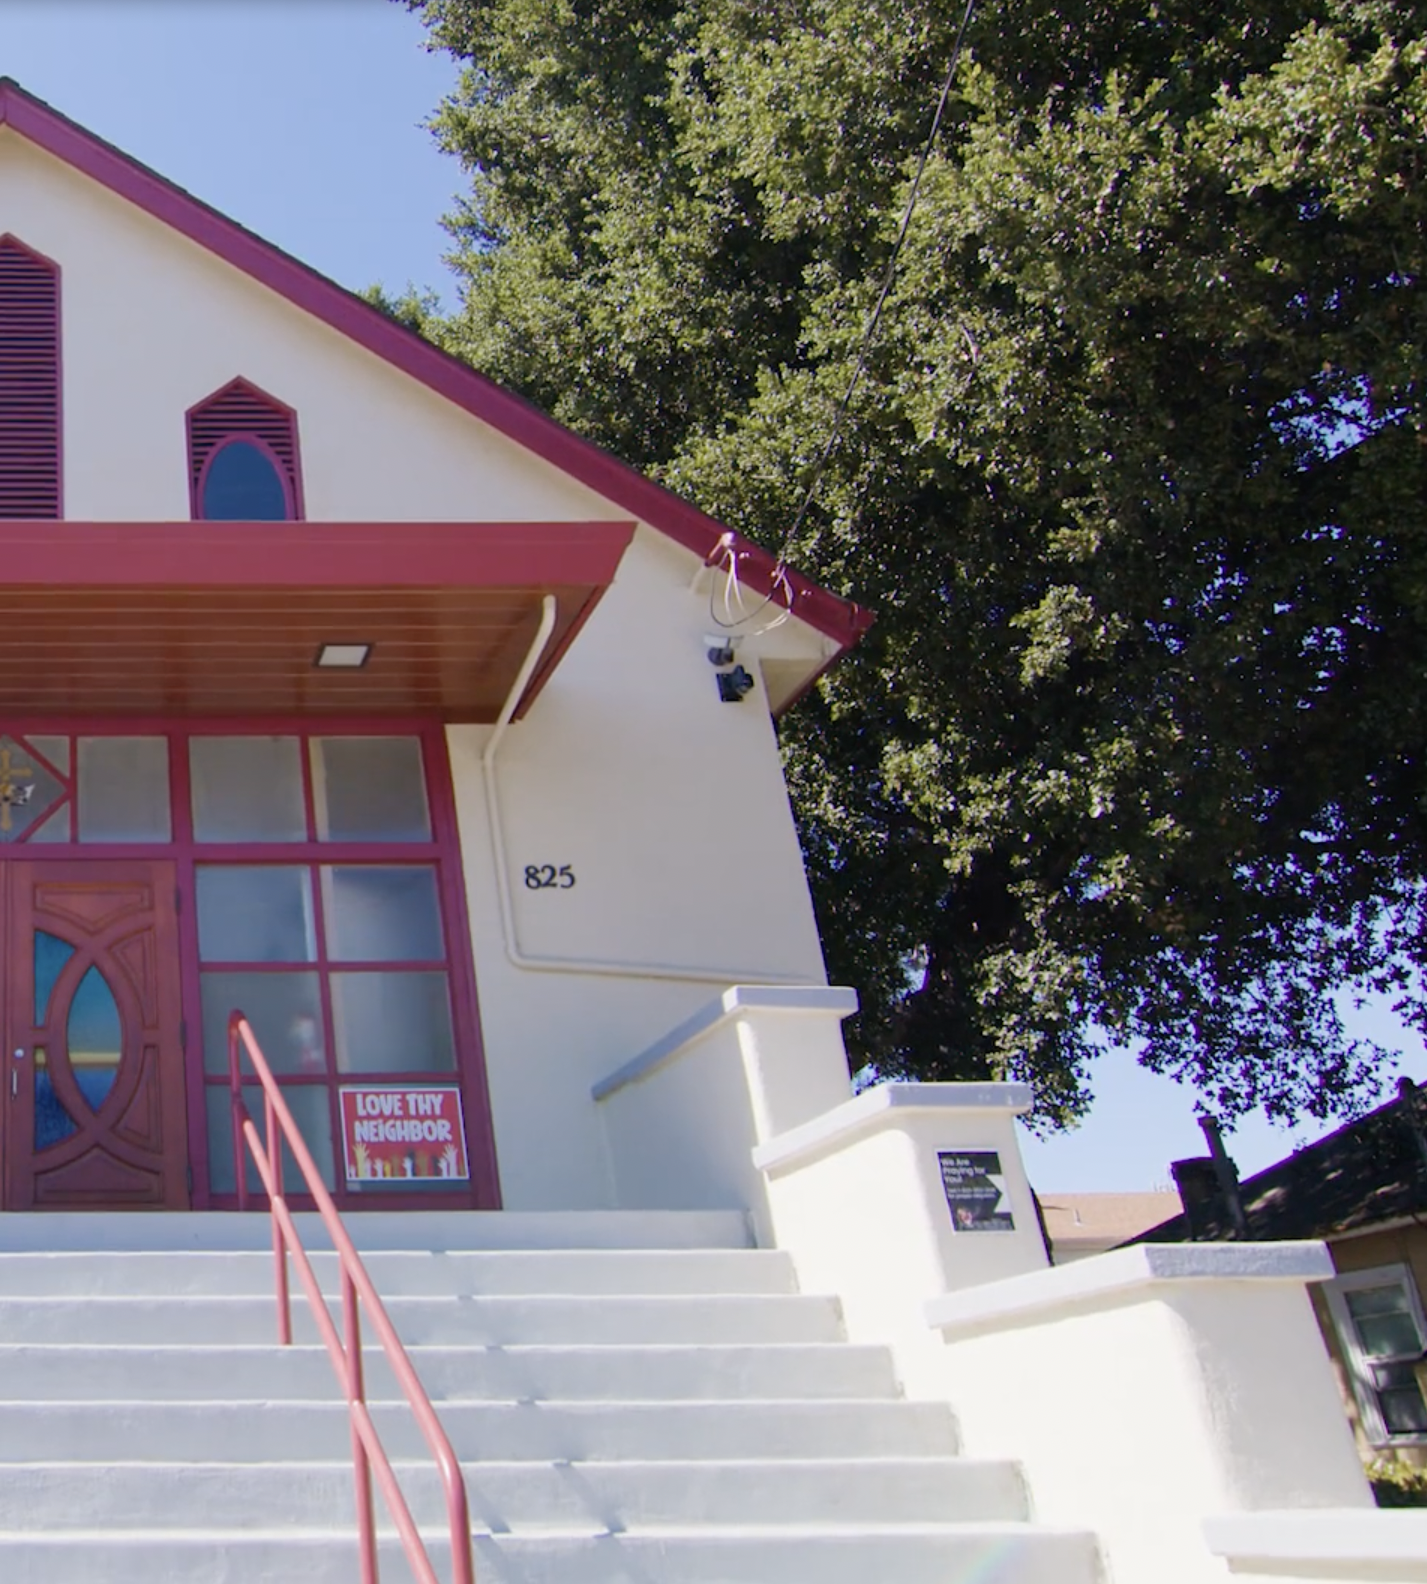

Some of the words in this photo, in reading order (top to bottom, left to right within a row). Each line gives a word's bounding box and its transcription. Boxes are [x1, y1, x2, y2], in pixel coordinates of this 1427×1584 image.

[525, 864, 575, 890] 825
[356, 1093, 404, 1117] LOVE
[406, 1093, 444, 1116] THY
[943, 1167, 974, 1177] Praying
